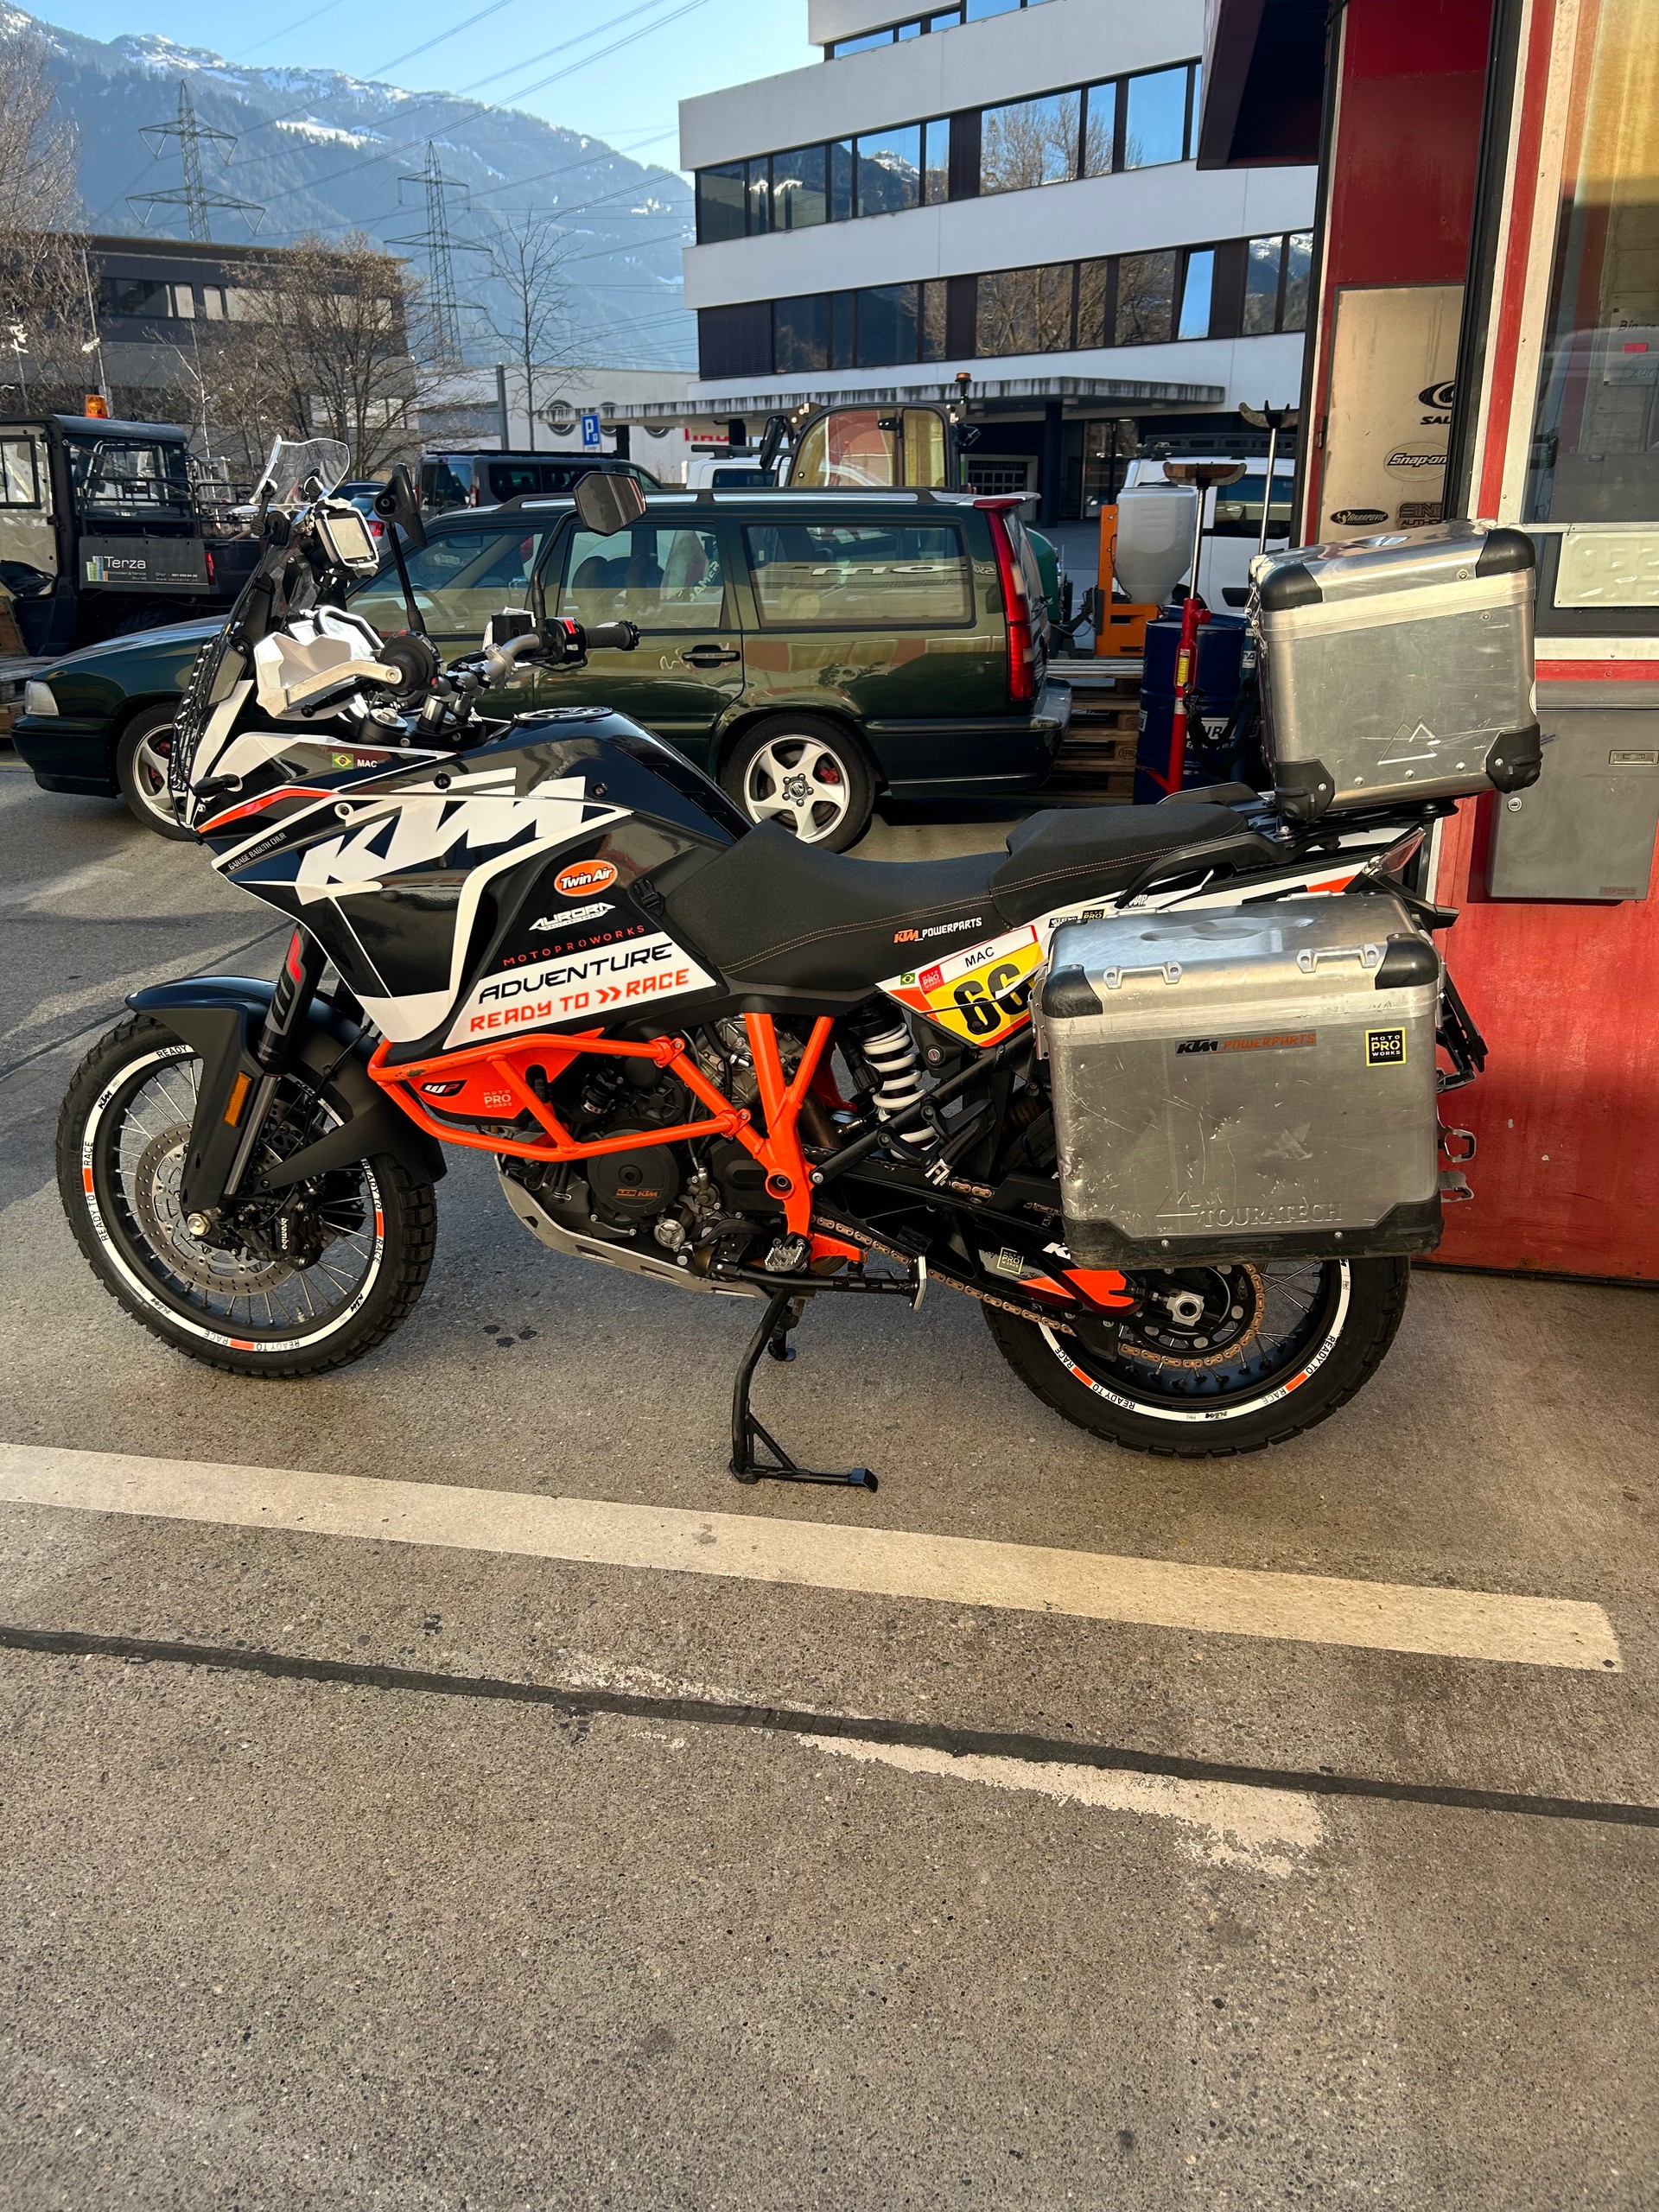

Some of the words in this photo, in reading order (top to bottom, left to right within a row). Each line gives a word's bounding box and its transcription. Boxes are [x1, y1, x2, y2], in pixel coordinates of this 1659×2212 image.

[585, 419, 594, 441] P
[1388, 453, 1447, 467] Snap-on
[104, 556, 147, 569] Terza
[357, 759, 378, 768] MAC
[296, 766, 586, 906] KTM
[228, 855, 251, 870] GARAGE
[249, 841, 271, 859] RAGUTH
[561, 873, 594, 890] Twin
[592, 867, 614, 881] Air
[529, 902, 616, 931] AURORA
[965, 946, 995, 968] MAC
[479, 942, 673, 1004] ADVENTURE
[923, 974, 939, 986] PRO
[470, 1001, 552, 1032] READY
[559, 991, 590, 1013] TO
[626, 969, 690, 998] RACE
[156, 1045, 188, 1059] READY
[1371, 1039, 1401, 1052] PRO
[99, 1090, 113, 1109] KTM
[484, 1095, 512, 1104] PRO
[84, 1141, 93, 1166] RACE
[86, 1194, 96, 1208] TO
[1200, 1202, 1344, 1227] TOURATECH
[91, 1212, 109, 1242] READY
[281, 1217, 289, 1250] brembo
[374, 1238, 384, 1264] RACE
[1002, 1254, 1020, 1264] PRO
[204, 1329, 229, 1345] RACE
[1054, 1346, 1074, 1369] RACE
[1316, 1335, 1336, 1363] READY
[1306, 1363, 1318, 1375] TO
[1093, 1383, 1104, 1395] TO
[1262, 1388, 1287, 1406] RACE
[1104, 1392, 1136, 1410] READY
